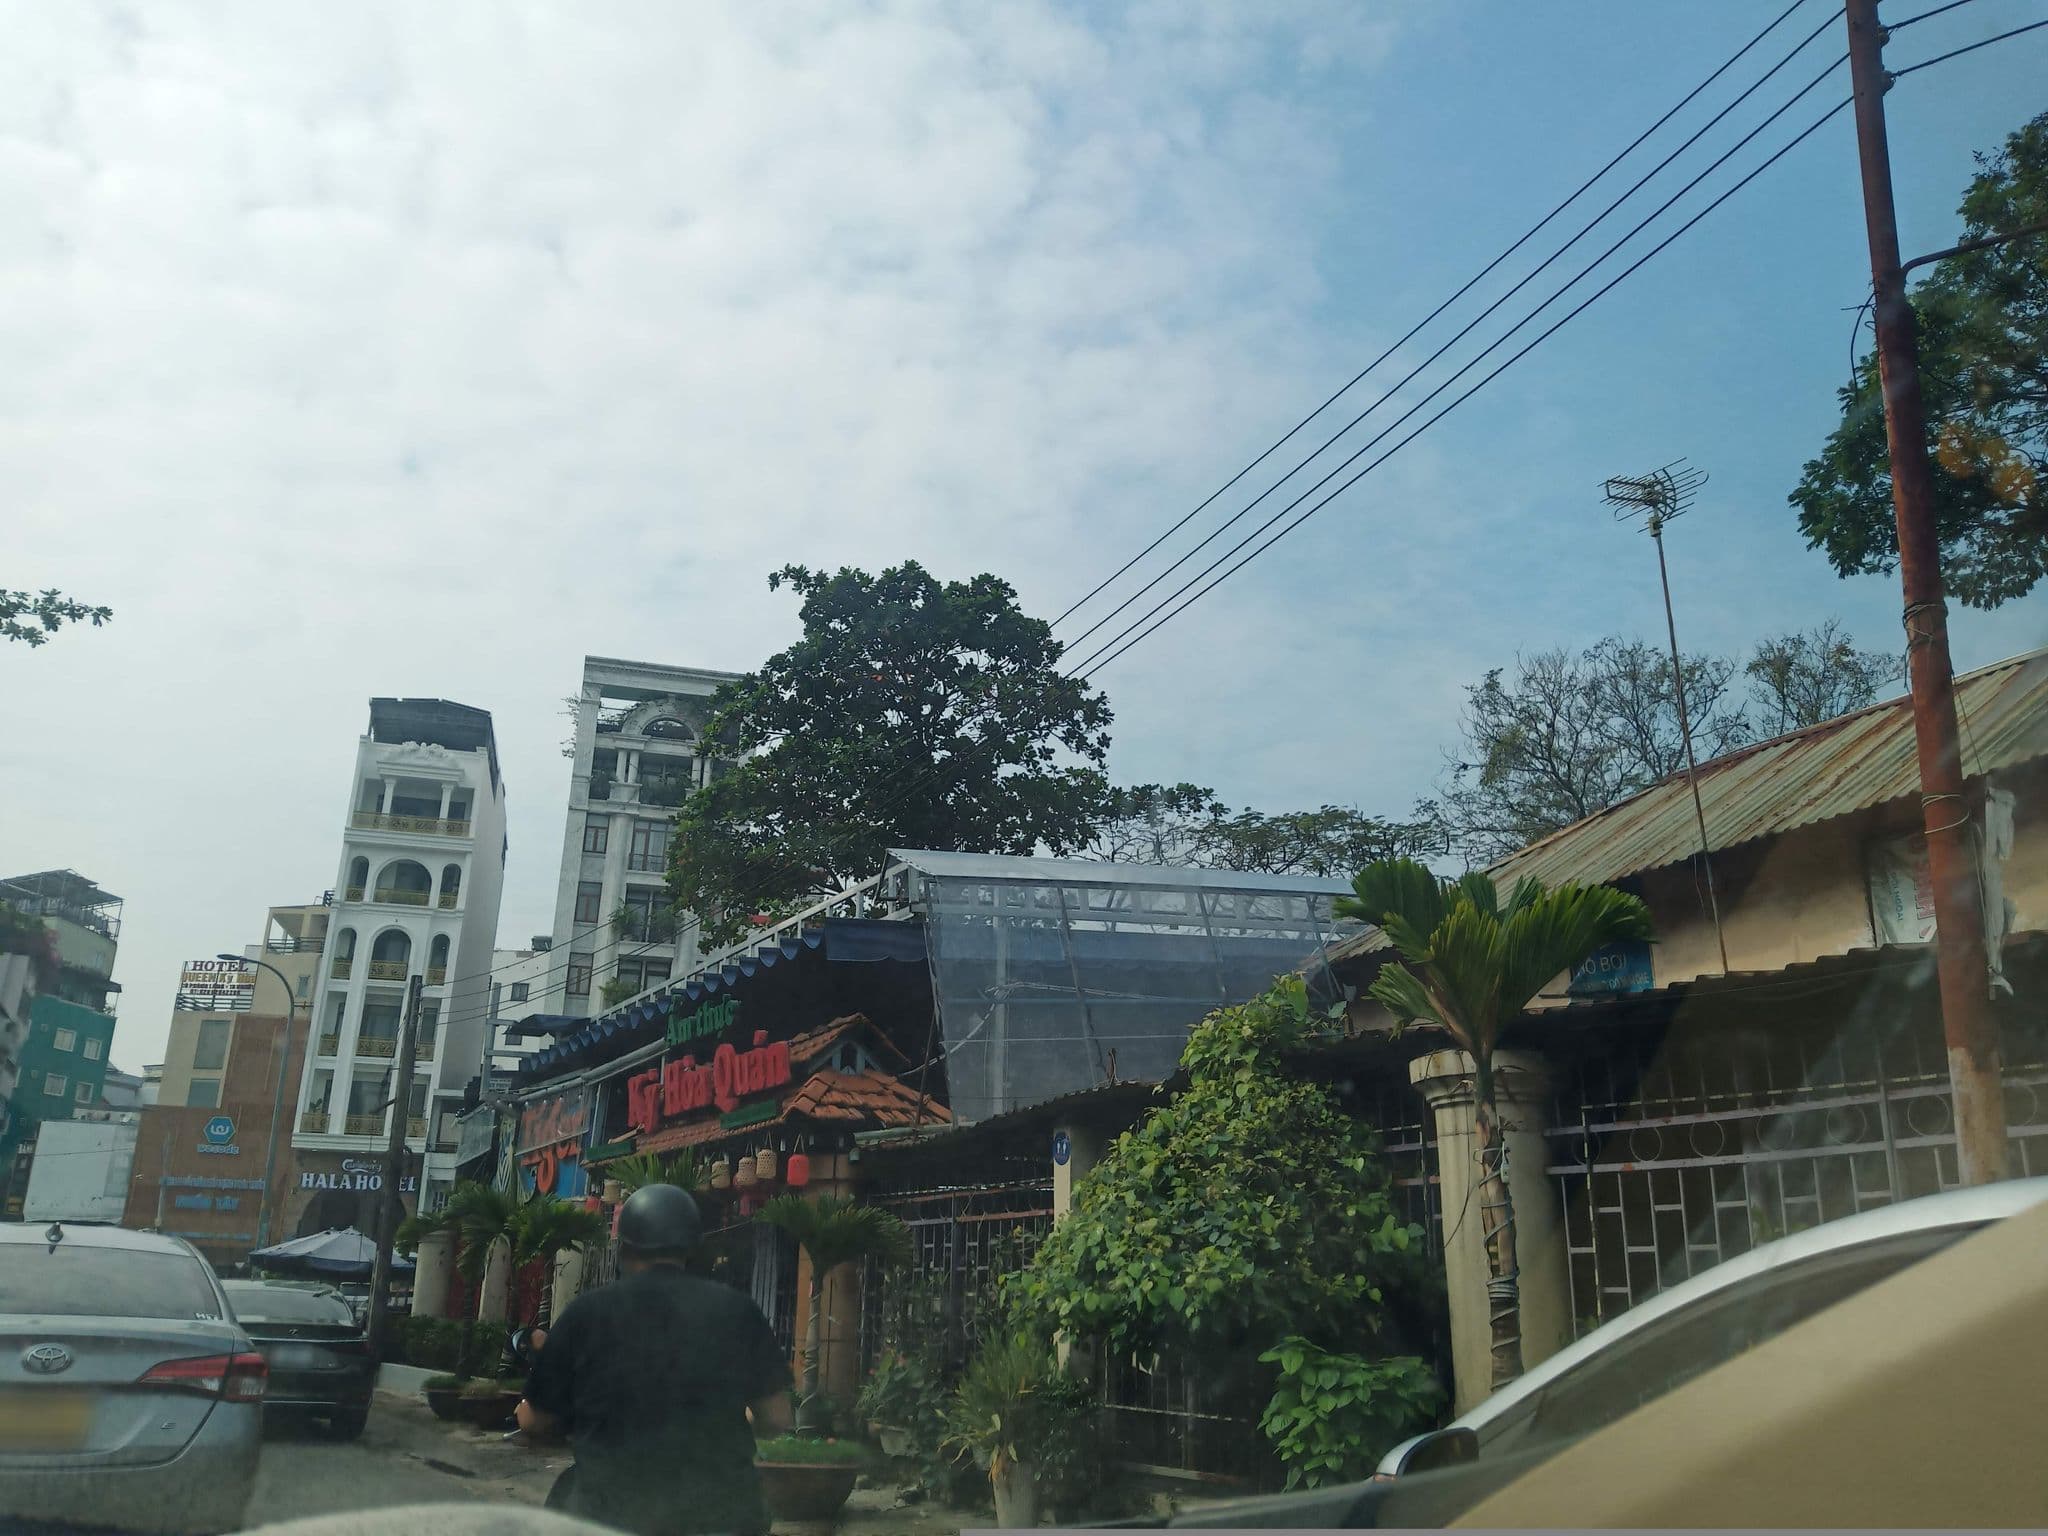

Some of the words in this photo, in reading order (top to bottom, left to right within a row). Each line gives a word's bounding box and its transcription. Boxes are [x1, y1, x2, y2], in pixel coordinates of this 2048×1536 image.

[191, 960, 249, 972] HOTEL
[301, 1172, 352, 1190] HALA
[355, 1174, 416, 1192] HOEL
